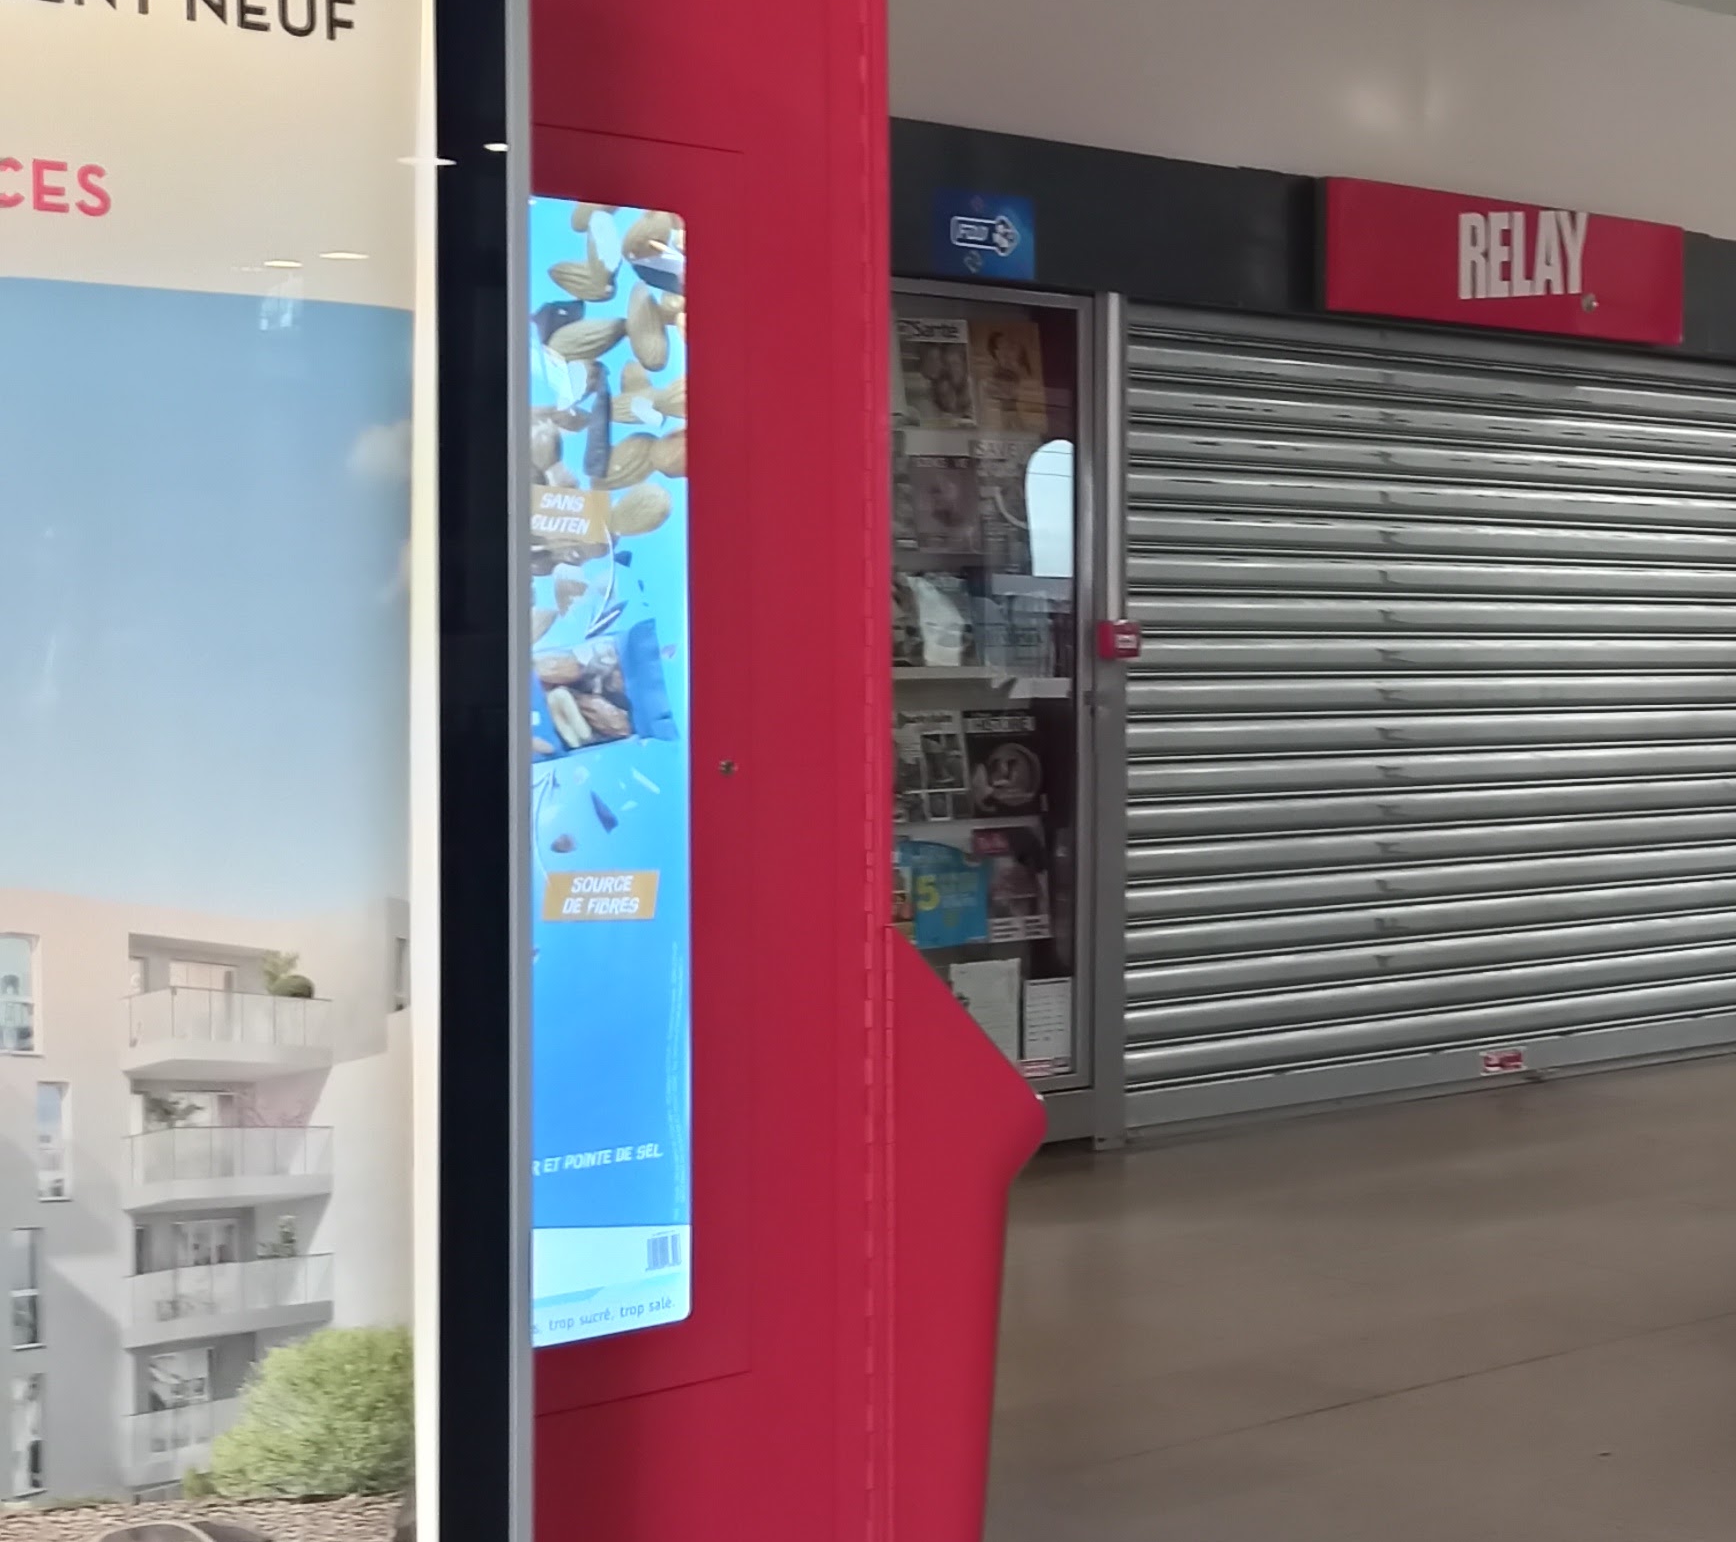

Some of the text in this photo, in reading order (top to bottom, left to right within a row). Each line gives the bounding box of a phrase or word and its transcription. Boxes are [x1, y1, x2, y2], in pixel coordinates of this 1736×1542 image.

[1458, 209, 1589, 300] RELAY
[541, 492, 585, 512] SANS
[571, 875, 634, 894] SOURCE
[562, 897, 640, 915] DE FIBRES
[543, 1156, 562, 1173] ET
[564, 1149, 612, 1170] POINTE
[615, 1146, 634, 1163] DE
[636, 1143, 663, 1161] SEL
[549, 1318, 575, 1332] trop
[620, 1303, 645, 1319] trop
